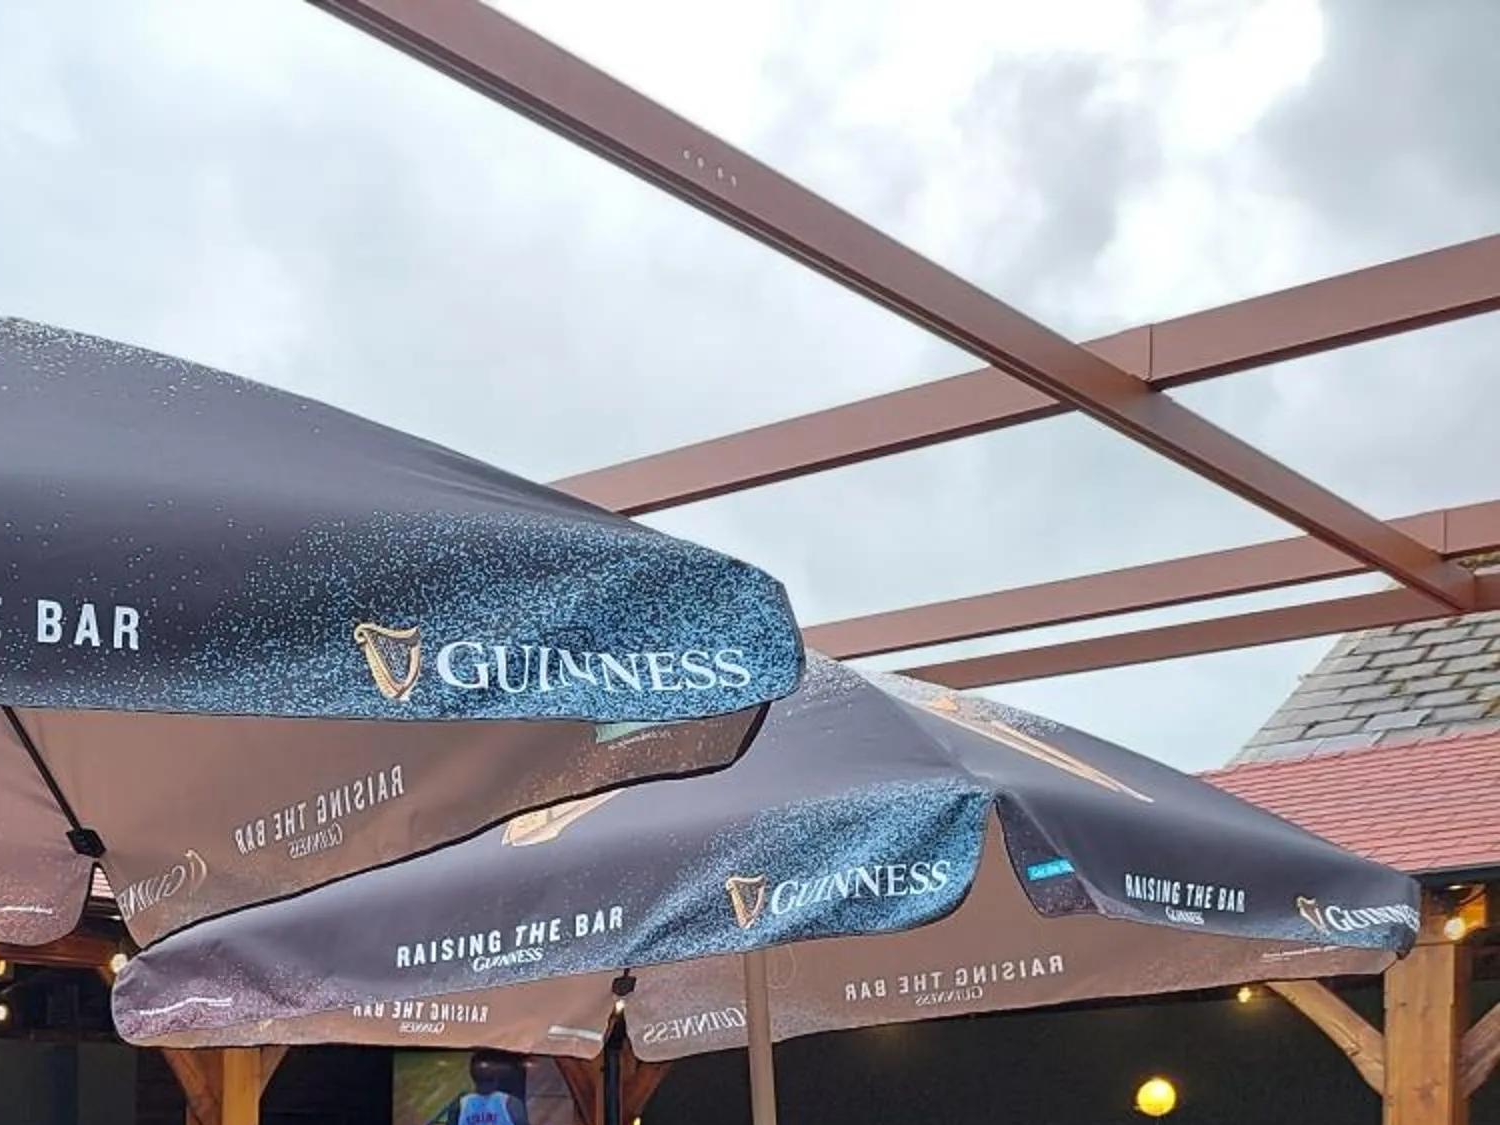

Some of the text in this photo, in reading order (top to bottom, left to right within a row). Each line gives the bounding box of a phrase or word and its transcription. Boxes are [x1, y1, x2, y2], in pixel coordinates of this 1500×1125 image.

[36, 600, 140, 651] BAR
[436, 641, 751, 693] GUINNESS
[771, 859, 951, 915] GUINNESS
[1125, 873, 1245, 914] RAISING THE BAR
[396, 905, 623, 968] RAISING THE BAR
